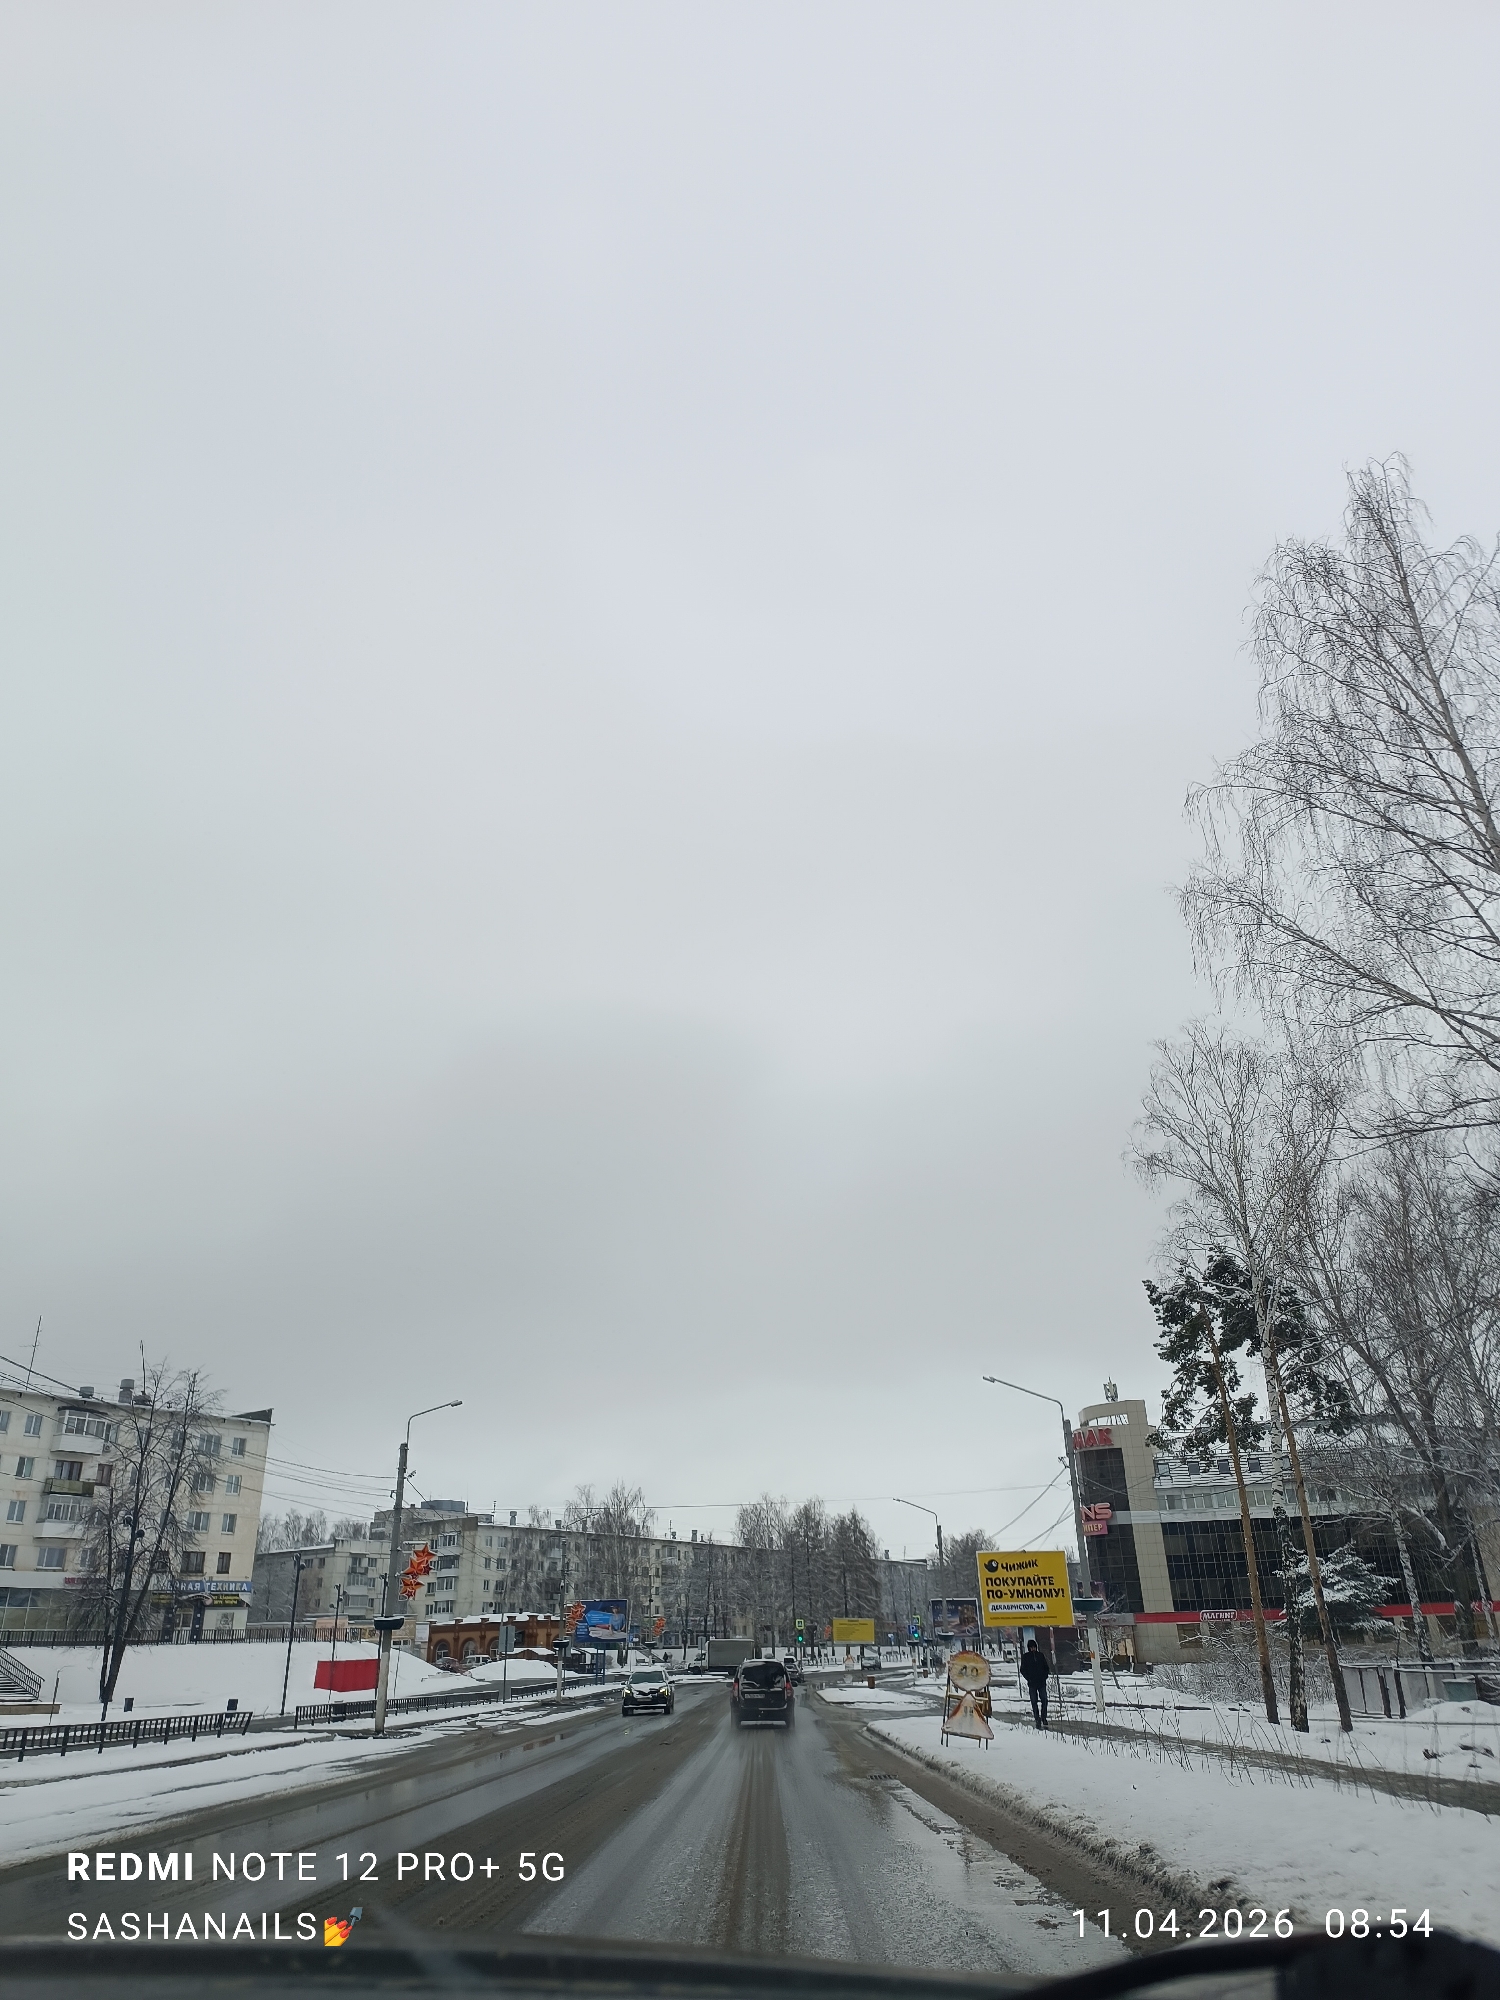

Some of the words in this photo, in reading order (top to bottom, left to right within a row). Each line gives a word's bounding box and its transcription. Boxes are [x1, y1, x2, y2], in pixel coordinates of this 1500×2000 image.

[985, 1573, 1055, 1587] ПОКУПАЙТЕ
[206, 1582, 248, 1591] ТЕХНИКА
[986, 1588, 1065, 1599] ПО-УМНОМУ!
[991, 1603, 1036, 1612] ДЕКАБРИСТОВ,
[958, 1665, 979, 1677] 40
